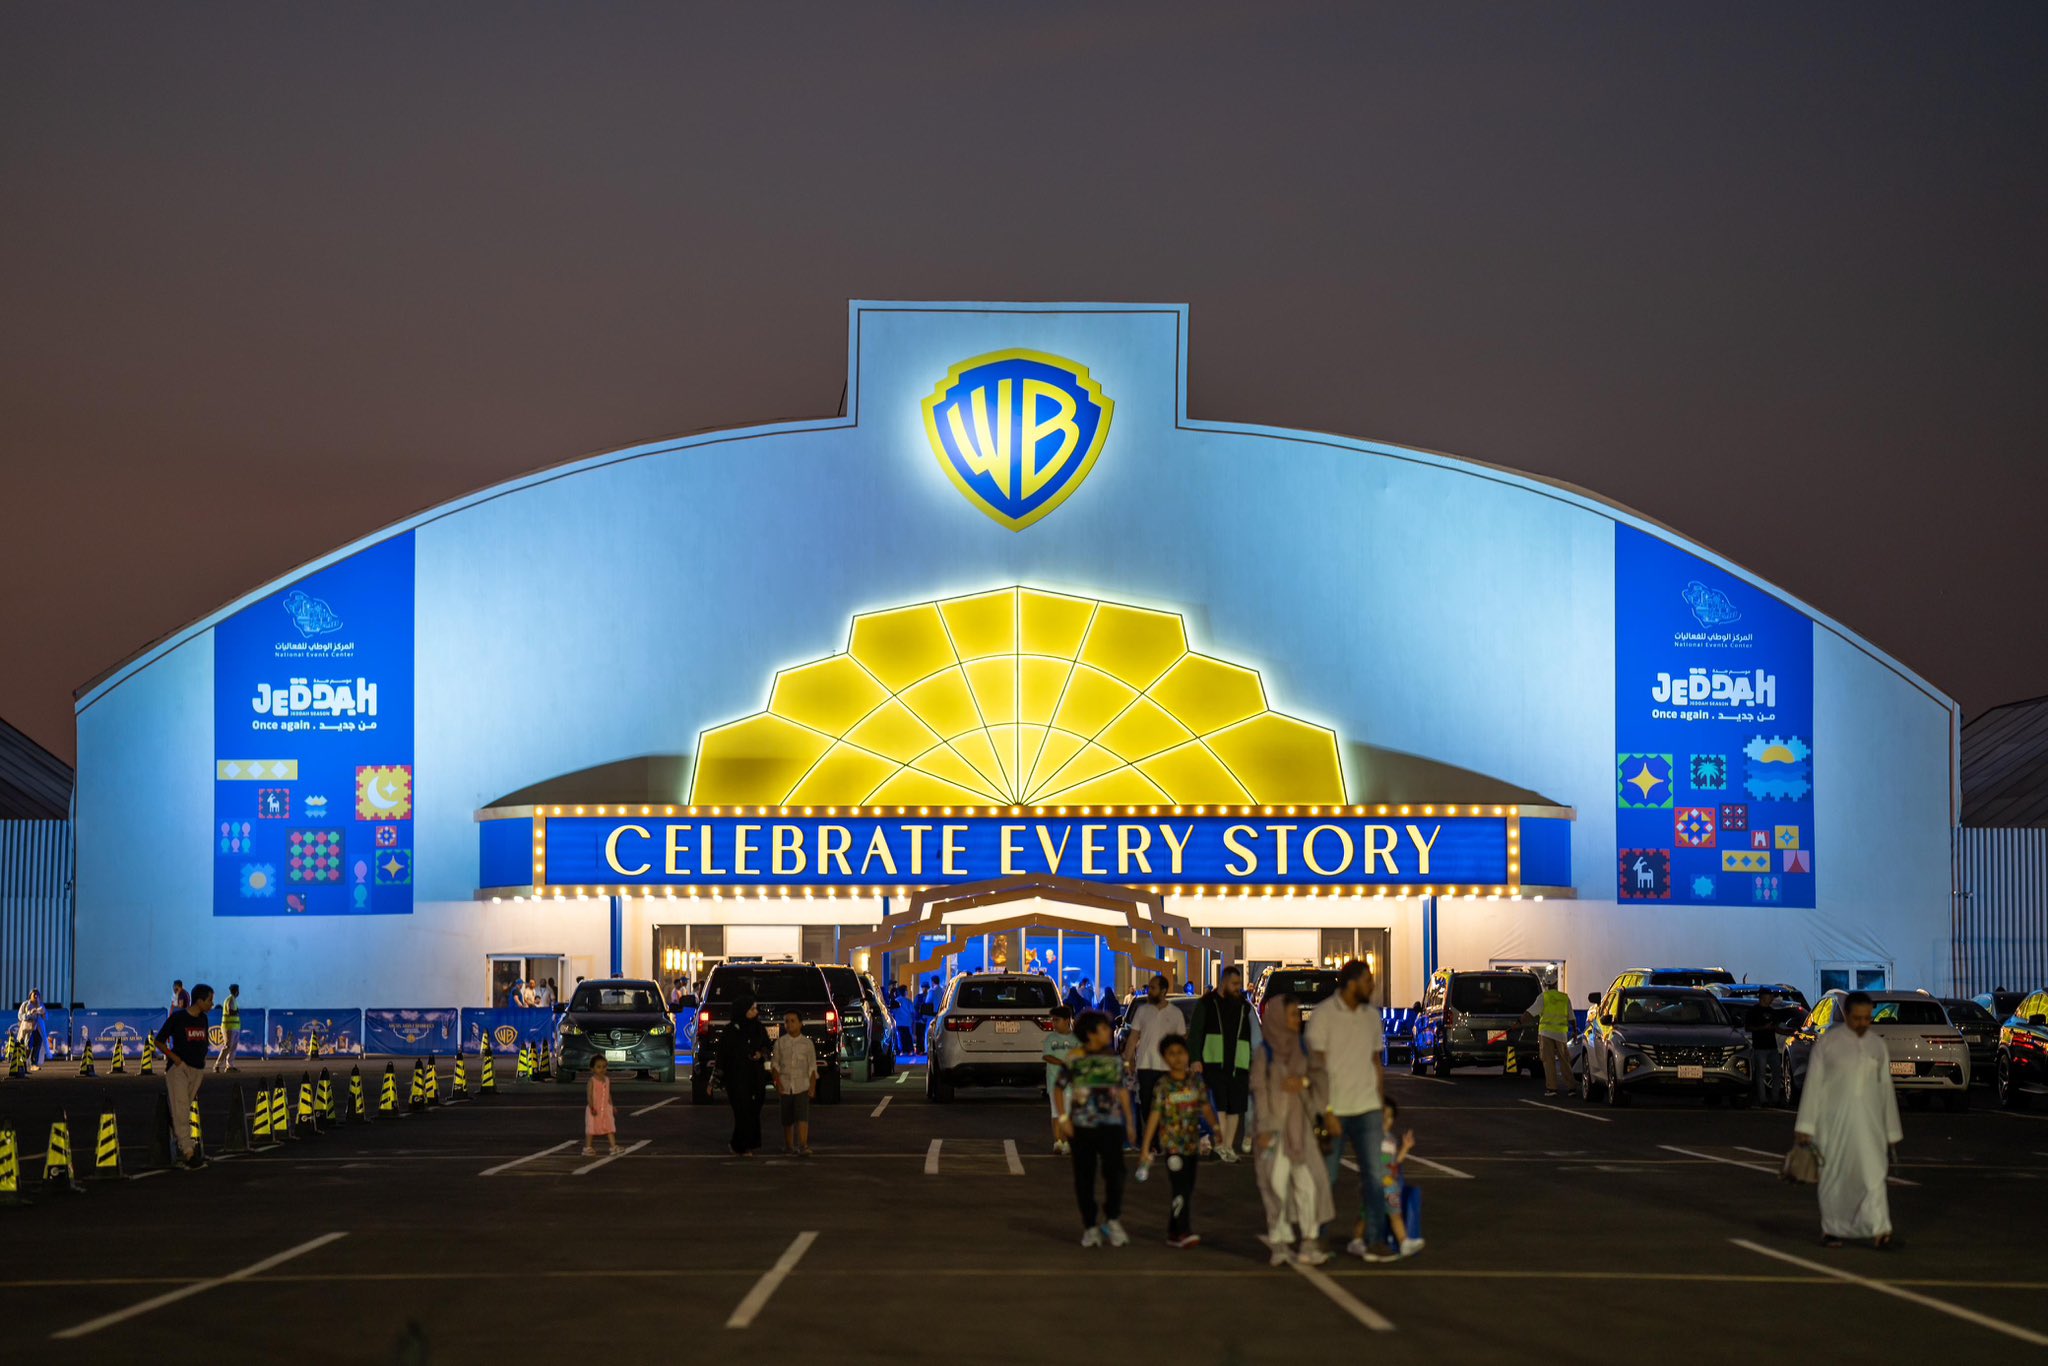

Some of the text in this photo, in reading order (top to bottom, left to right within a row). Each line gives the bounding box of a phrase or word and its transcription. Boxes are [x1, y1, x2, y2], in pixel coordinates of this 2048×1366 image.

[946, 378, 1080, 501] WB
[1674, 632, 1706, 641] للفعاليات
[1732, 633, 1753, 642] المركز
[275, 642, 307, 651] للفعاليات
[333, 642, 354, 652] المركز
[1652, 667, 1776, 707] JEDDAH
[252, 677, 377, 716] JEDDAH
[1652, 709, 1709, 721] Once again
[1718, 711, 1776, 723] من جديد
[252, 720, 310, 732] Once again
[319, 720, 377, 732] من جديد
[605, 824, 1442, 876] CELEBRATE EVERY STORY
